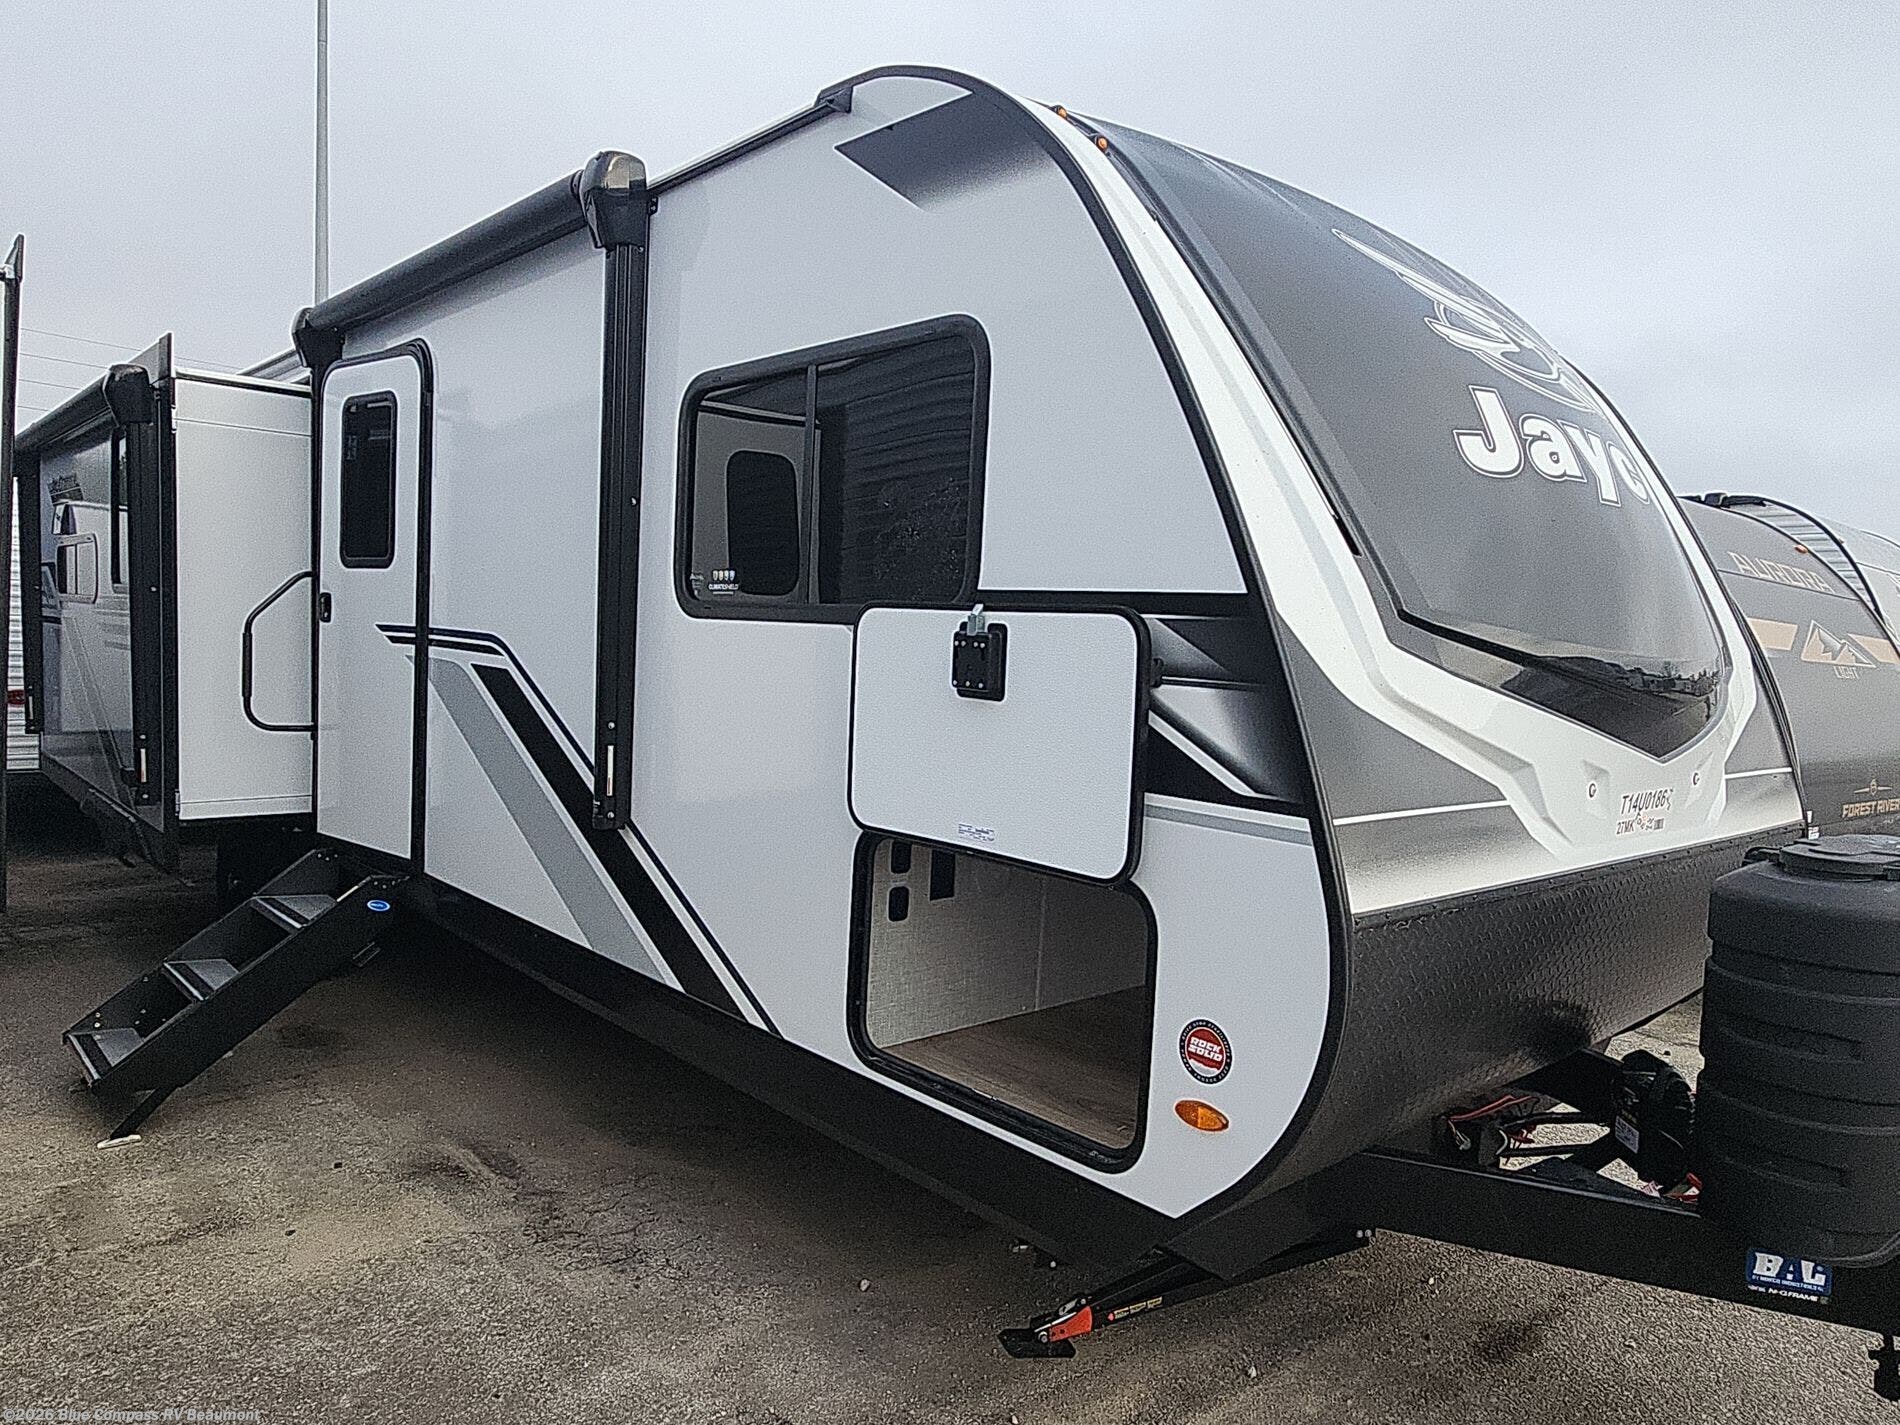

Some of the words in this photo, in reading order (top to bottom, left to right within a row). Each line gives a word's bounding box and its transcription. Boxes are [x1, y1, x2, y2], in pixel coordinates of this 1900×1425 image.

[1727, 551, 1836, 594] AURORA
[1842, 801, 1877, 819] FOREST
[1188, 1045, 1223, 1061] SOLID
[1190, 1036, 1222, 1054] ROCK
[1752, 1252, 1827, 1287] BAL
